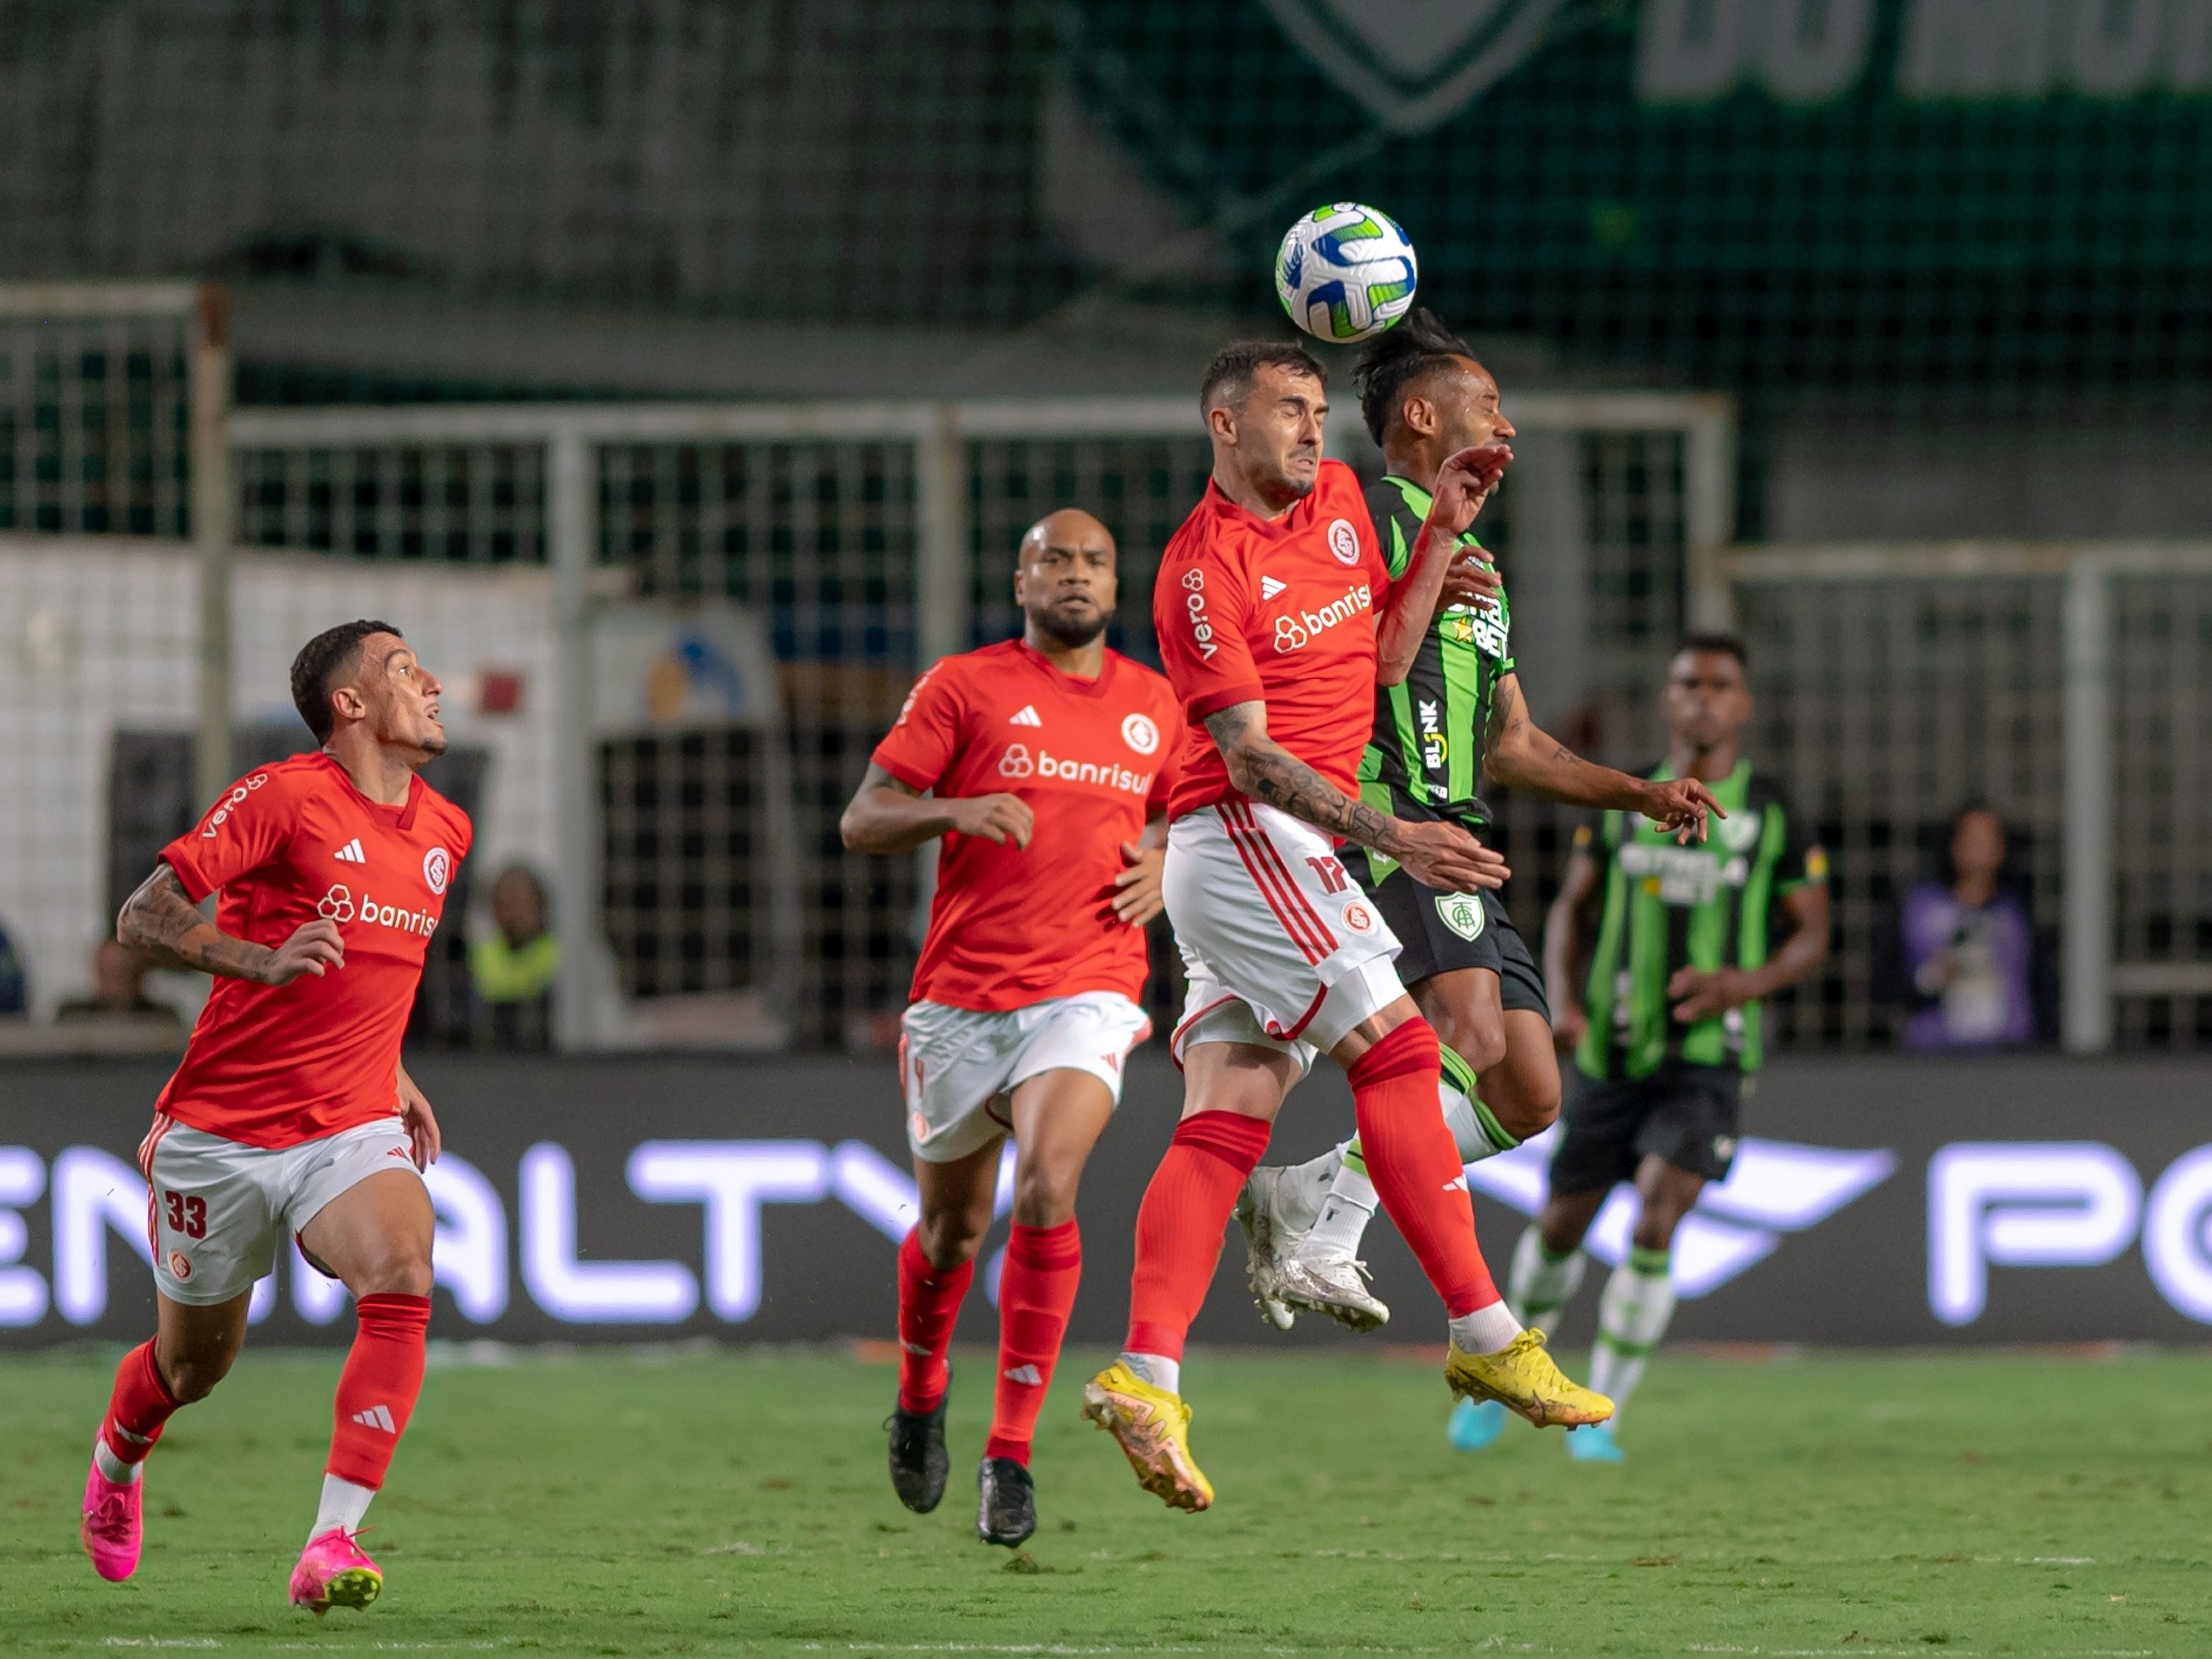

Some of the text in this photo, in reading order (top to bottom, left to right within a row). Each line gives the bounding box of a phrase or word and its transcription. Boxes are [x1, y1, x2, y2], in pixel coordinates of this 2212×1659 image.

[1187, 592, 1218, 661] vero
[201, 786, 248, 838] vero
[165, 1189, 207, 1240] 33
